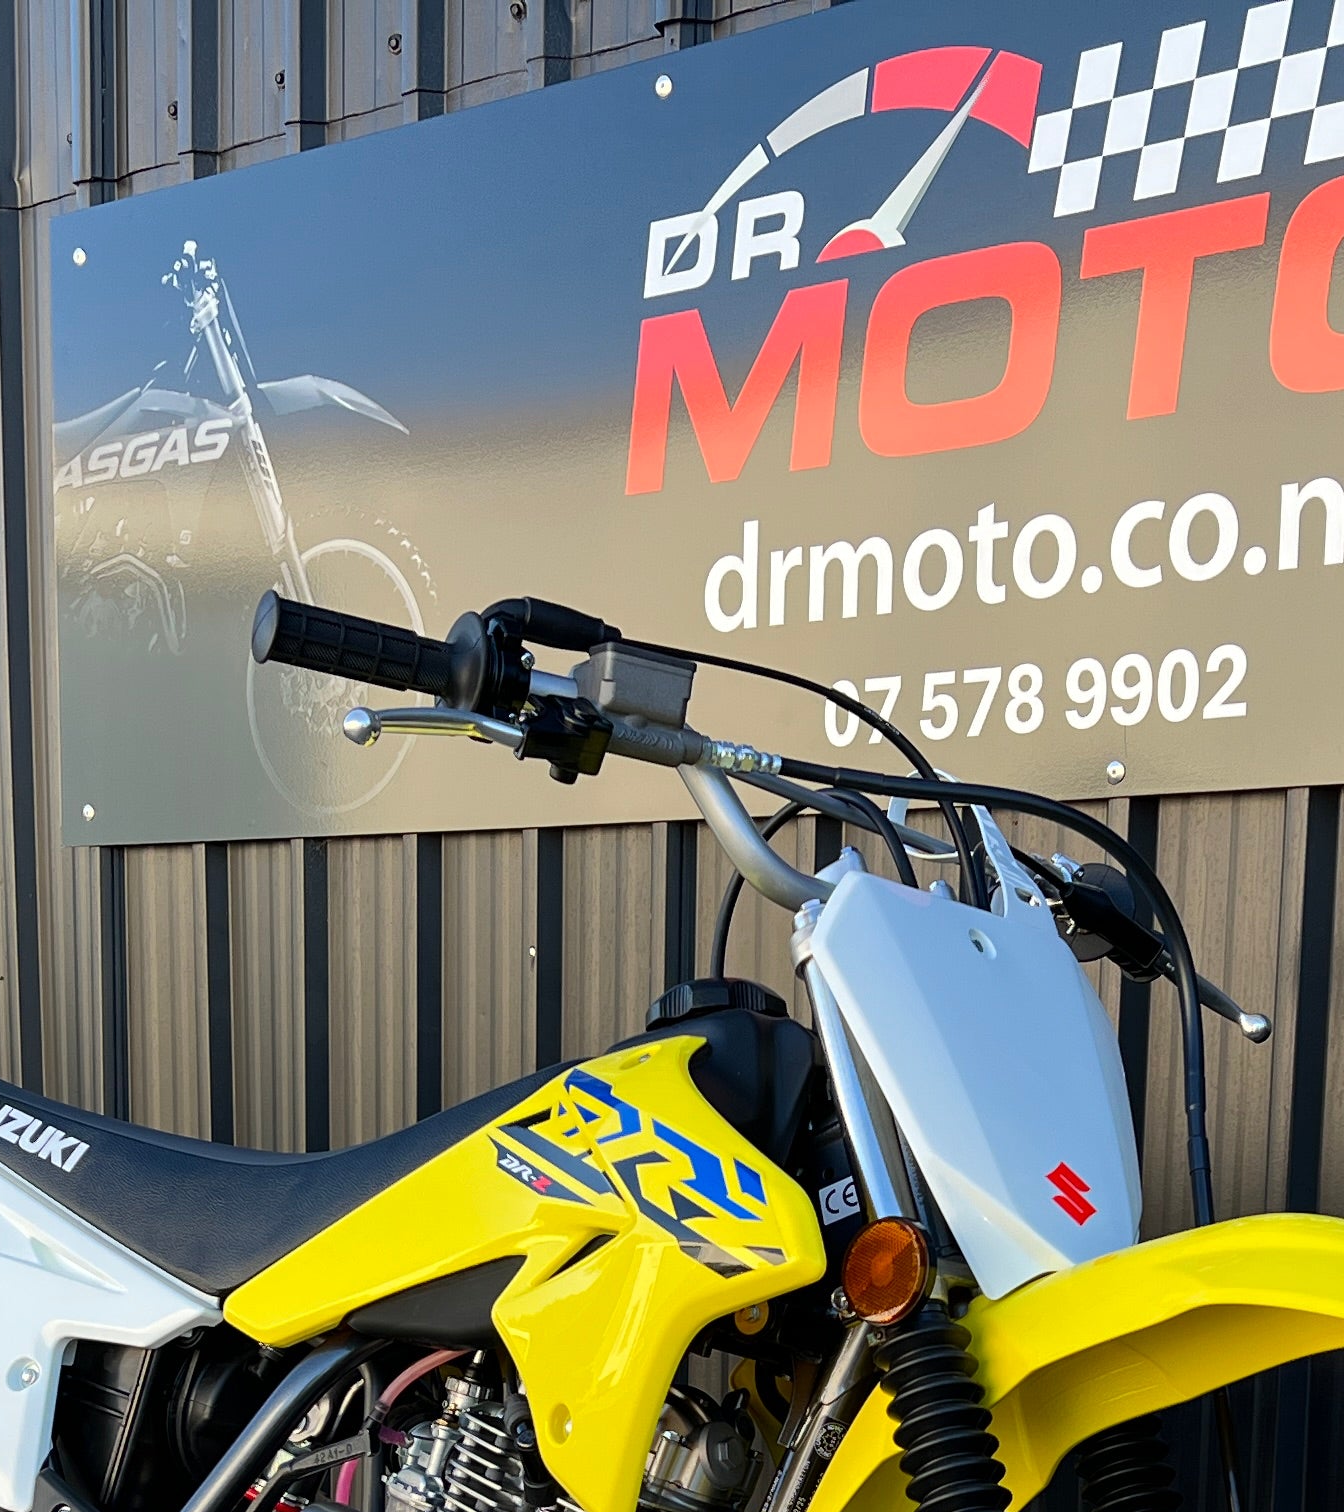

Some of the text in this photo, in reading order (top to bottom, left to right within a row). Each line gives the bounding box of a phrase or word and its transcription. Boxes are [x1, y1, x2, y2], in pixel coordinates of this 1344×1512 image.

[643, 190, 805, 300] DR
[918, 662, 1045, 742] 578
[1064, 643, 1248, 730] 9902
[825, 1181, 859, 1215] CE
